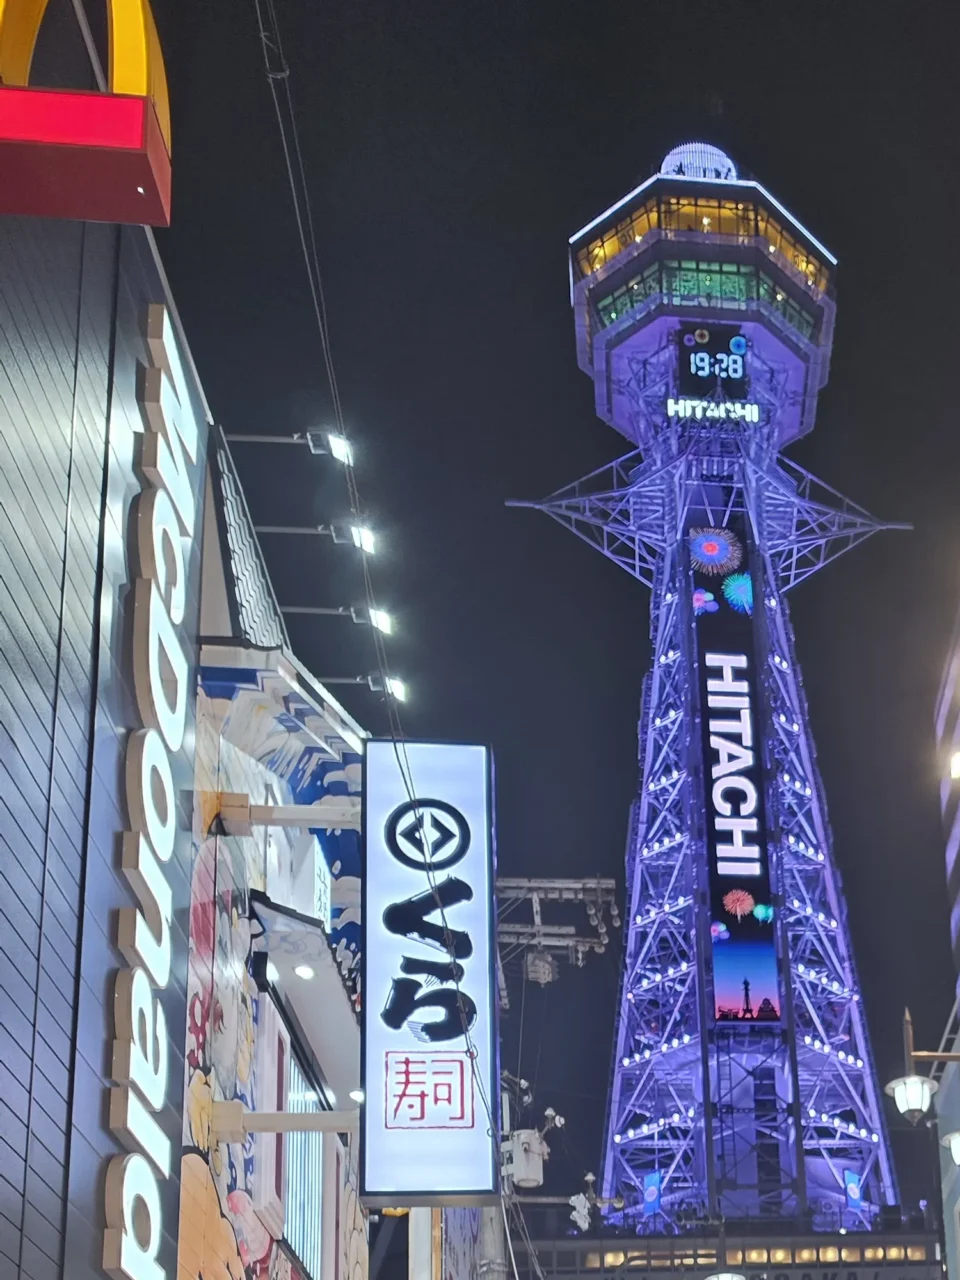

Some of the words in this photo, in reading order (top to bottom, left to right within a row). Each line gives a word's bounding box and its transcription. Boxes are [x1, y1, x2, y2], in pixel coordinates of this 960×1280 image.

[690, 352, 743, 378] 19:28
[667, 398, 759, 423] HITACHI
[705, 653, 761, 875] HITACHI
[380, 875, 477, 1042] くら
[392, 1058, 467, 1122] 寿司
